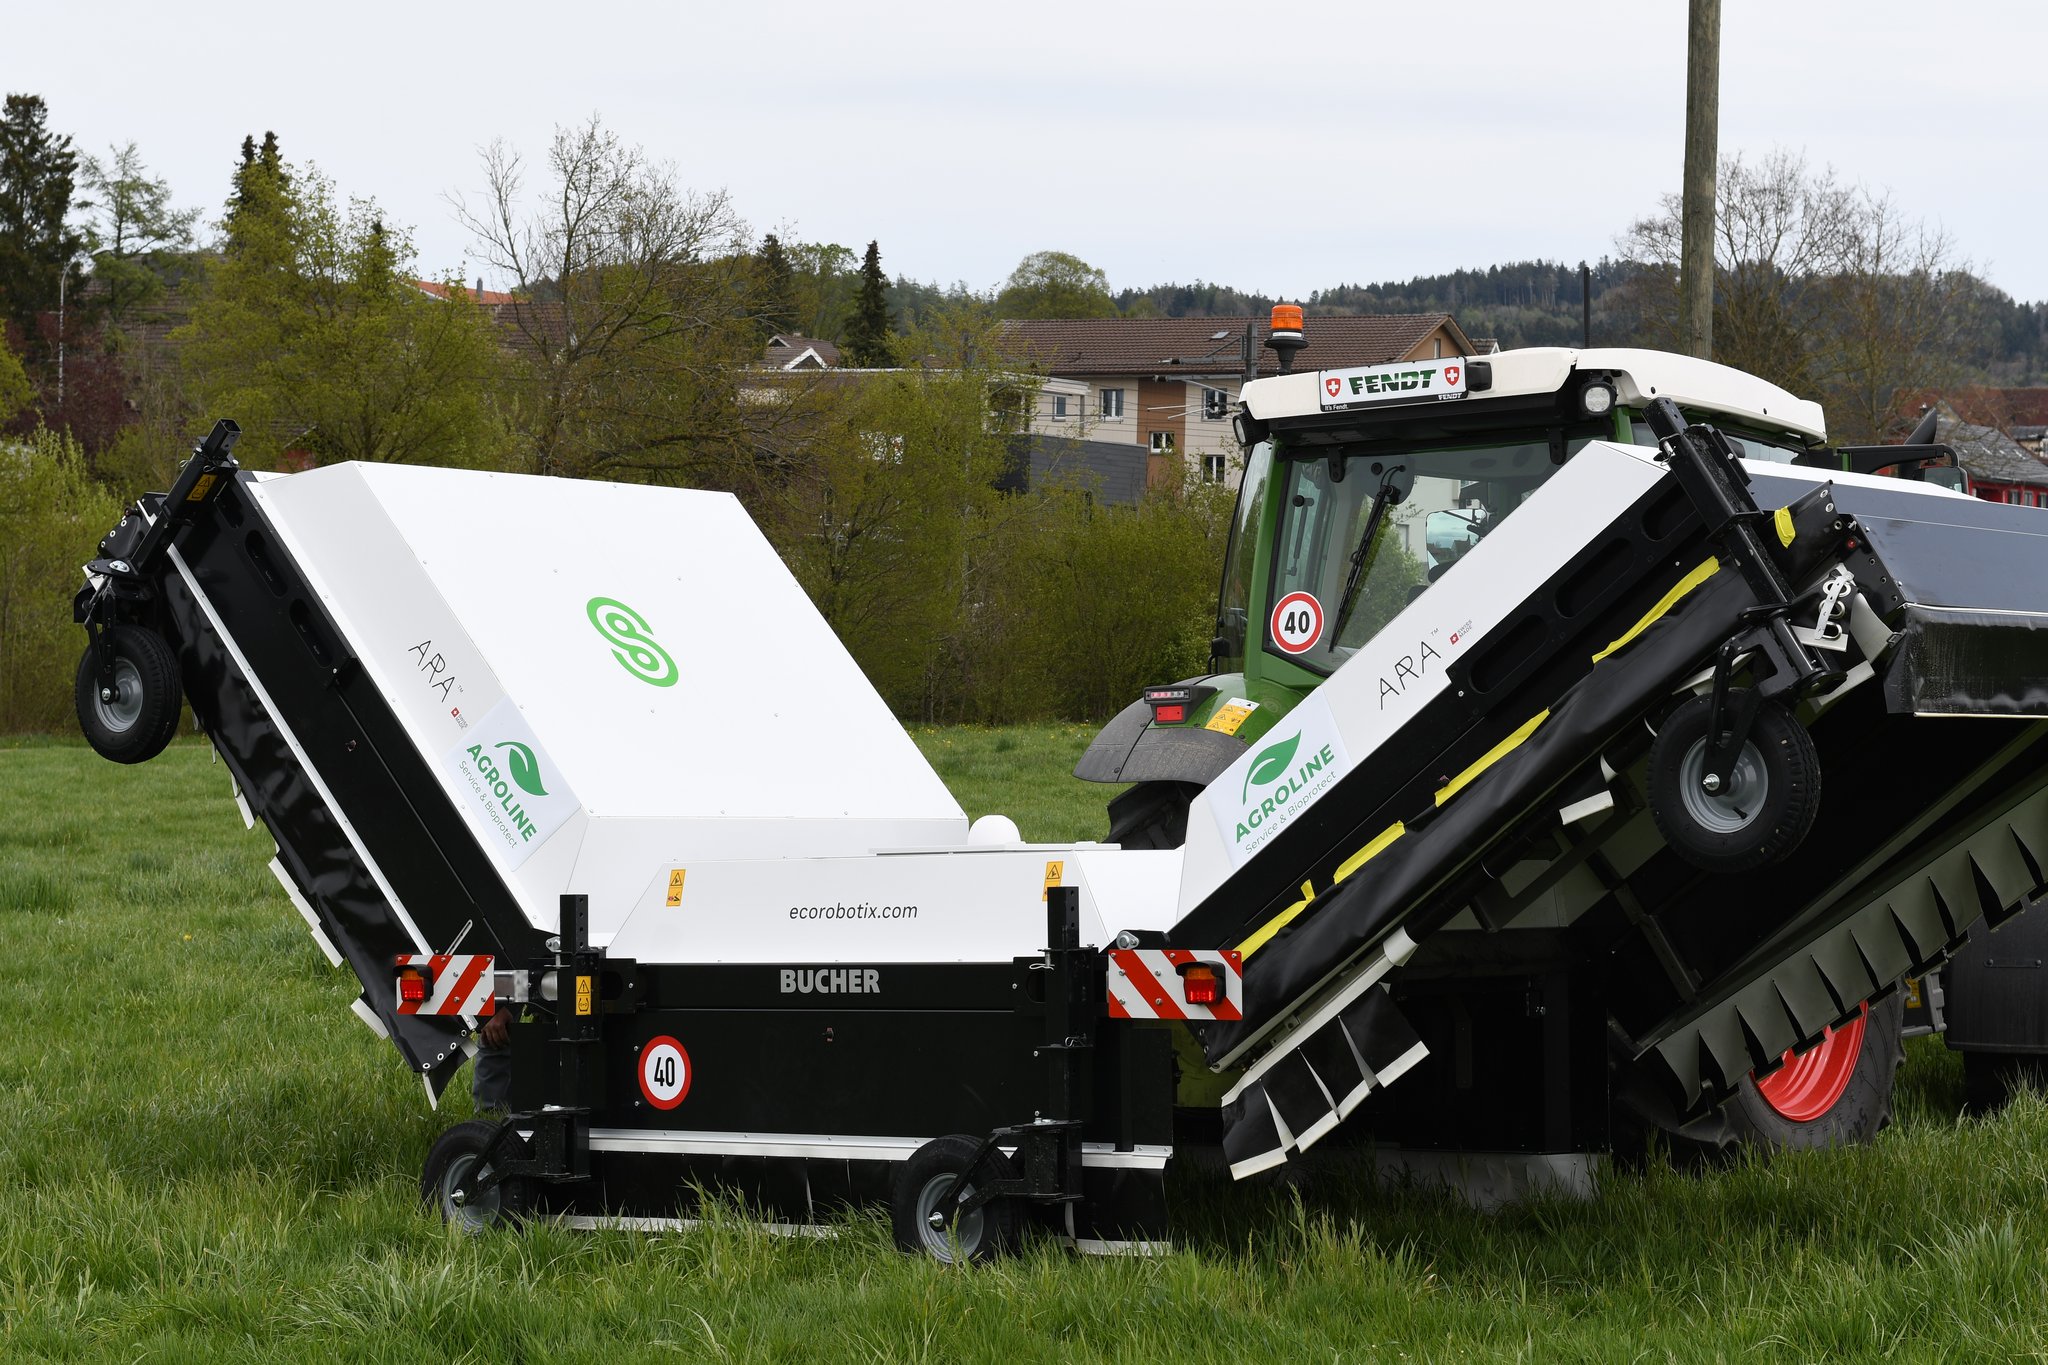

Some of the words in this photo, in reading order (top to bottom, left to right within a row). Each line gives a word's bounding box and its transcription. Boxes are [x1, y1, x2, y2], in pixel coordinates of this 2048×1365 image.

[1348, 369, 1437, 395] FENDT
[1438, 392, 1463, 401] FENDT
[1284, 611, 1310, 634] 40
[408, 640, 455, 703] ARA
[1380, 641, 1441, 710] ARA
[459, 760, 481, 794] Service
[480, 793, 488, 802] &
[484, 800, 518, 848] Bioprotect
[466, 744, 537, 842] AGROLINE
[1236, 743, 1335, 844] AGROLINE
[1245, 822, 1278, 854] Service
[1279, 814, 1287, 824] &
[1287, 770, 1336, 816] Bioprotect
[789, 902, 918, 919] ecorobotix.com
[780, 969, 880, 993] BUCHER
[654, 1057, 675, 1087] 40
